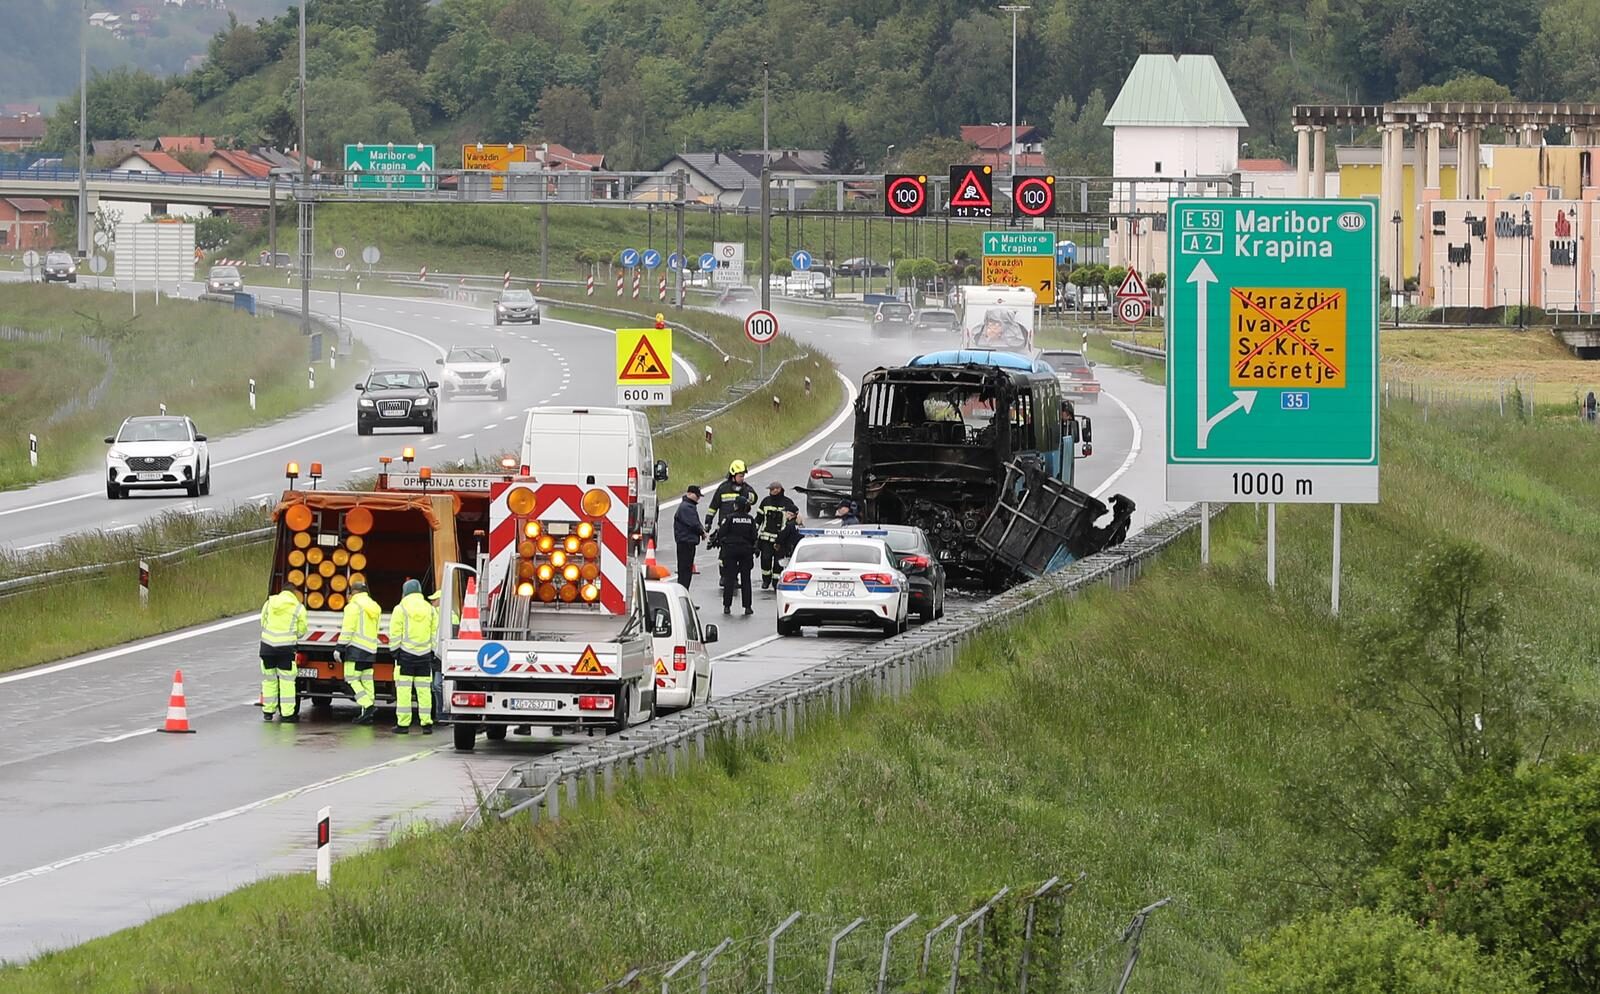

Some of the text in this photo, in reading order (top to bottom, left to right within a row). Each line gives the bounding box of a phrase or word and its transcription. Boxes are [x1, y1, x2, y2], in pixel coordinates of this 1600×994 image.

[370, 150, 406, 160] Maribor
[370, 160, 406, 170] Krapina
[895, 189, 917, 203] 100
[1024, 190, 1045, 204] 100
[1186, 212, 1220, 228] E 59
[1235, 209, 1361, 233] Maribor SLO
[1001, 234, 1038, 243] Maribor
[1190, 236, 1213, 250] A 2
[1001, 244, 1038, 254] Krapina
[1235, 234, 1333, 263] Krapina
[1239, 292, 1338, 310] Varaždin
[1124, 304, 1140, 318] 80
[751, 319, 773, 336] 100
[1238, 314, 1311, 332] Ivanec
[1238, 360, 1335, 384] Začretje
[624, 390, 664, 401] 600 m
[1287, 394, 1303, 408] 35
[458, 478, 489, 488] CESTE
[1232, 472, 1313, 496] 1000 m
[816, 590, 856, 598] POLICIJA
